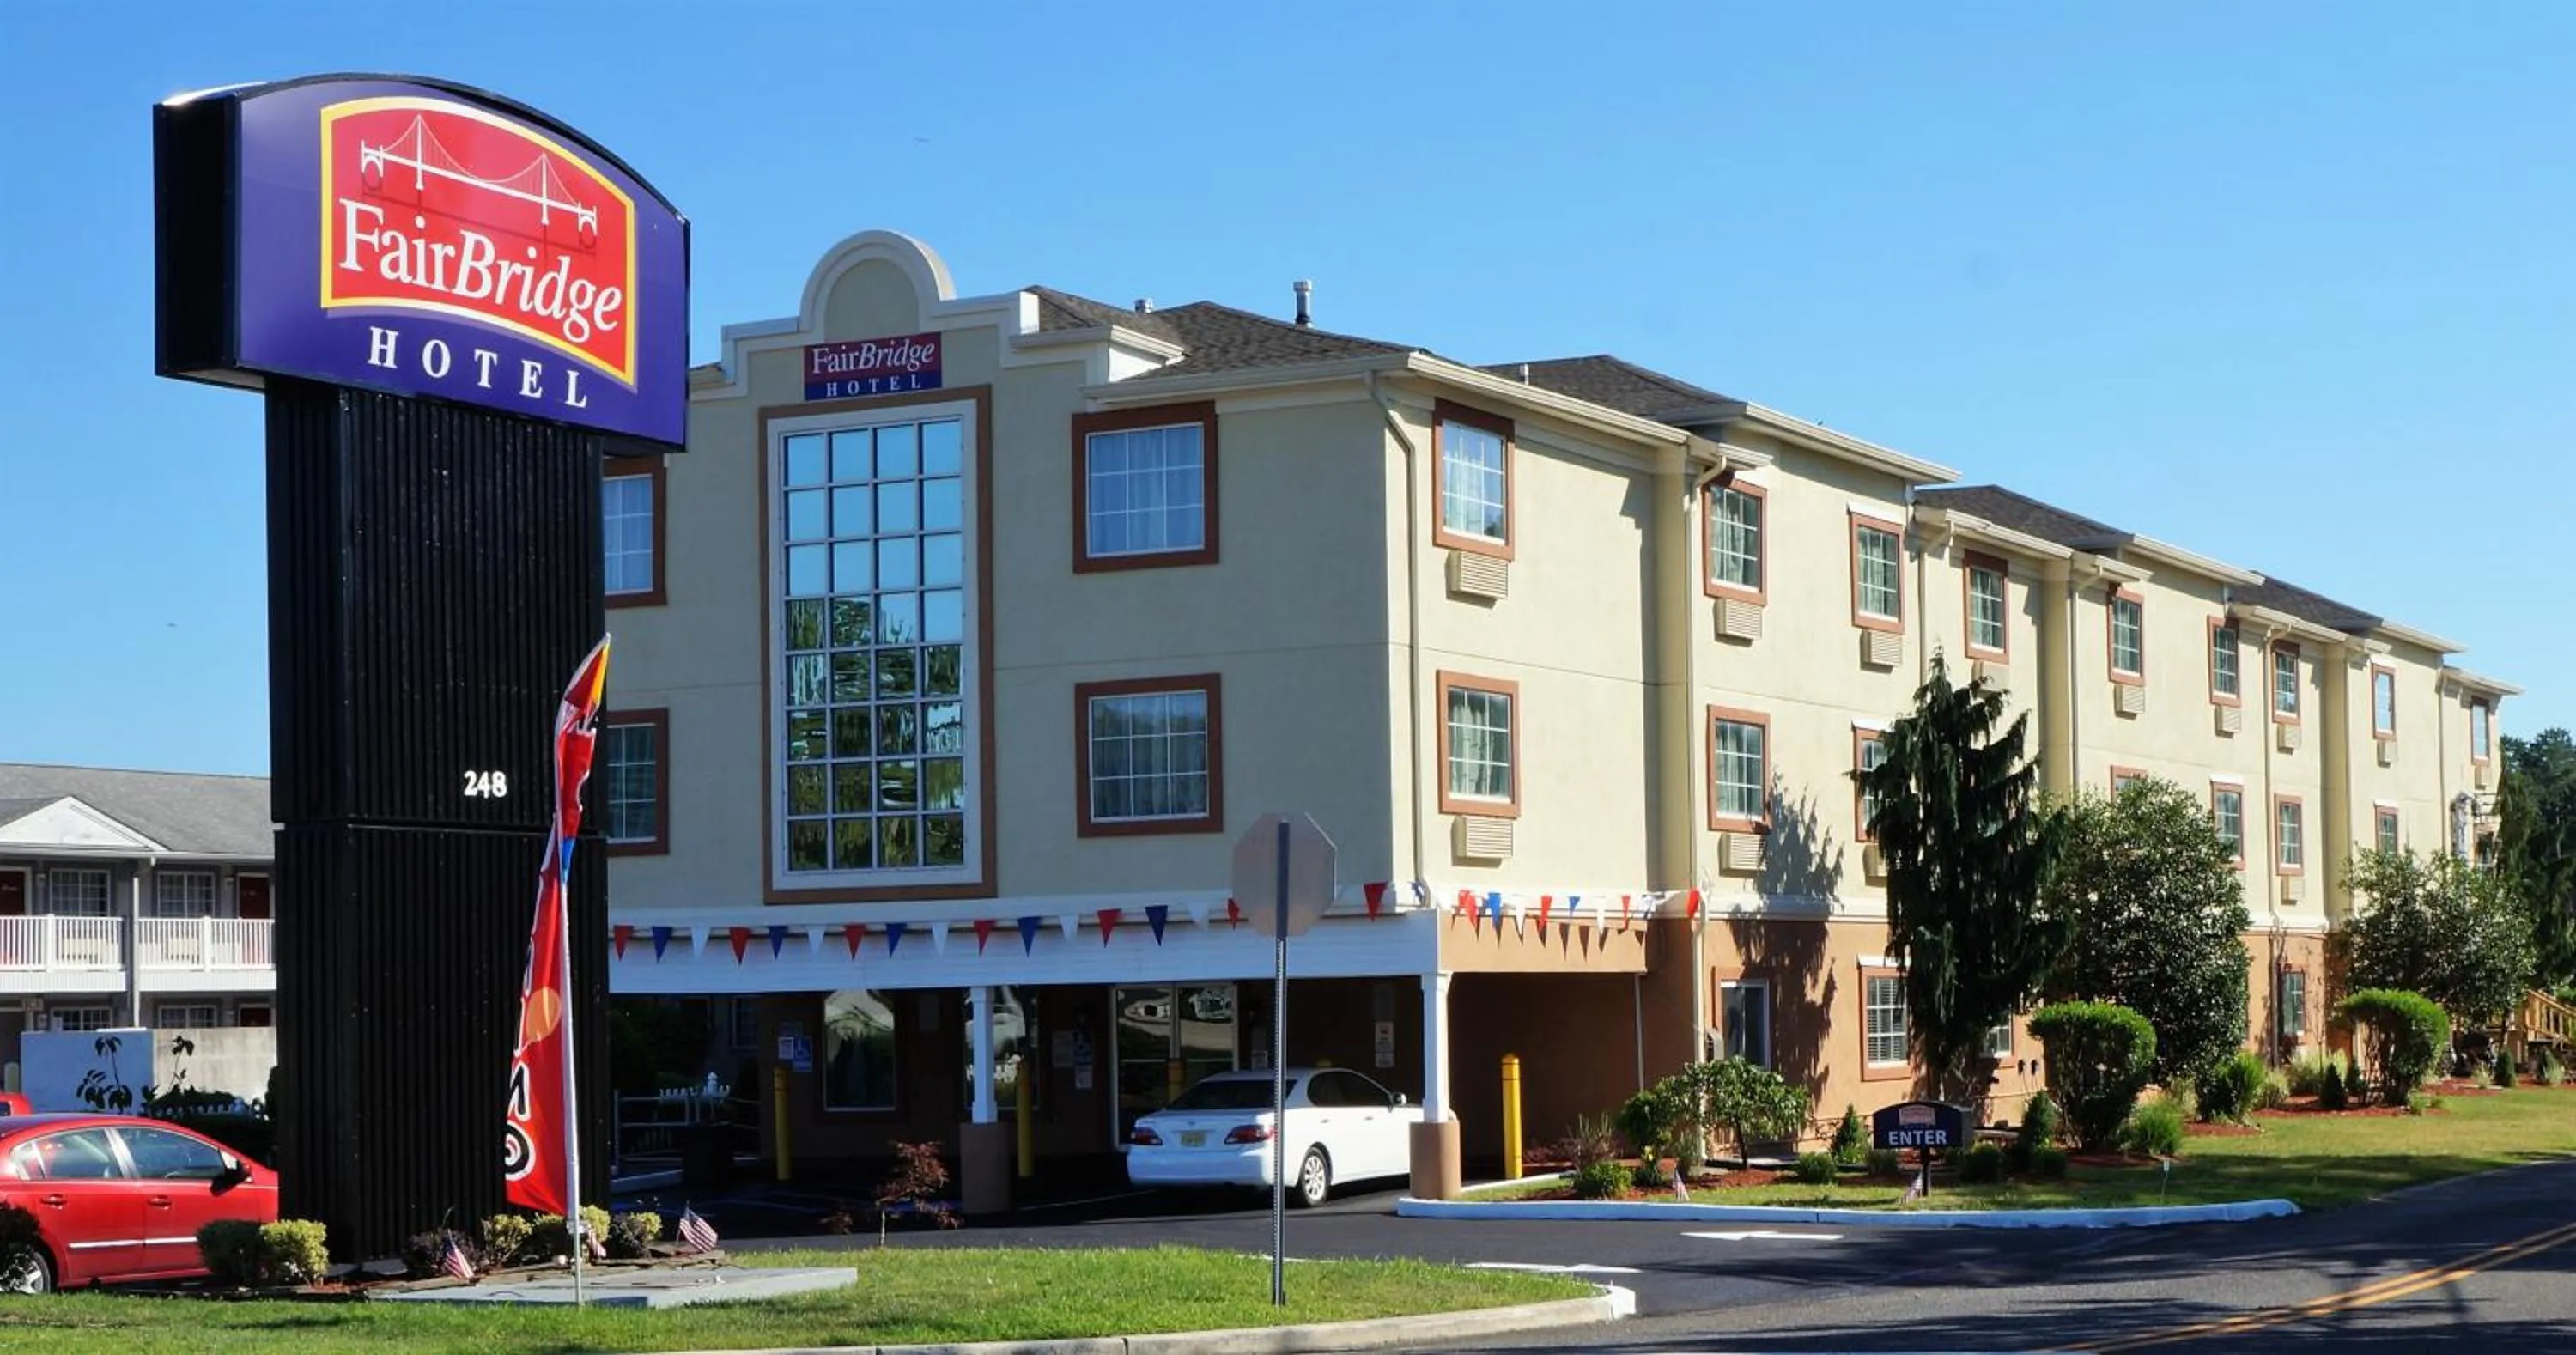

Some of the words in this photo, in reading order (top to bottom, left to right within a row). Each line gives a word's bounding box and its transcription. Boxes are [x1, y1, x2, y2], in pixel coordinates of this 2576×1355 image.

[338, 197, 623, 343] FairBridge
[367, 325, 587, 408] HOTEL
[812, 338, 935, 374] FairBridge
[826, 374, 921, 398] HOTEL
[464, 769, 507, 799] 248
[1888, 1129, 1947, 1145] ENTER
